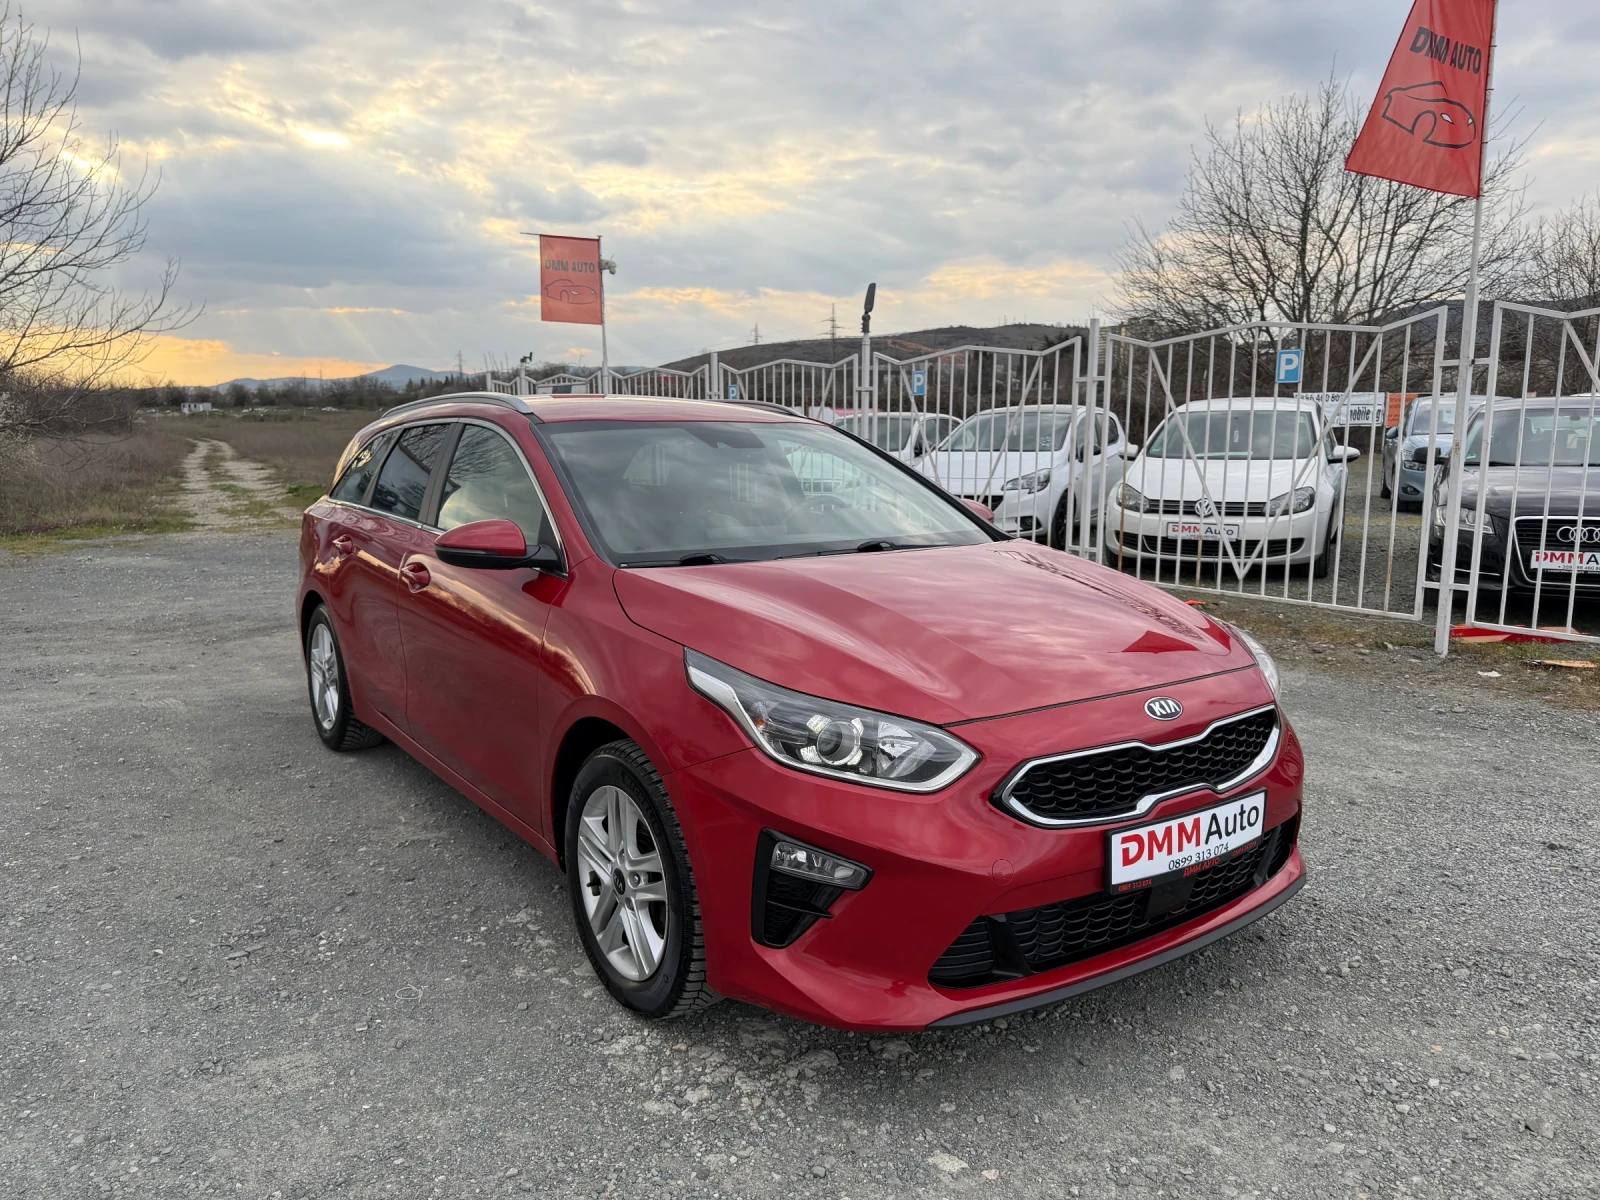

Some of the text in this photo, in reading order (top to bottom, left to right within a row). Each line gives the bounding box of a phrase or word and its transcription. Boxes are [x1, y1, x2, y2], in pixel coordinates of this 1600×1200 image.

[1450, 41, 1482, 74] AUTO
[545, 259, 596, 273] DMM AUTO
[1279, 354, 1299, 380] P
[914, 374, 924, 393] P
[729, 387, 737, 400] P
[1204, 526, 1234, 536] Auo
[1535, 551, 1585, 565] DMM
[1149, 699, 1181, 716] KIA
[1120, 803, 1260, 868] DMM Auto
[1168, 841, 1229, 871] 0899 313 074
